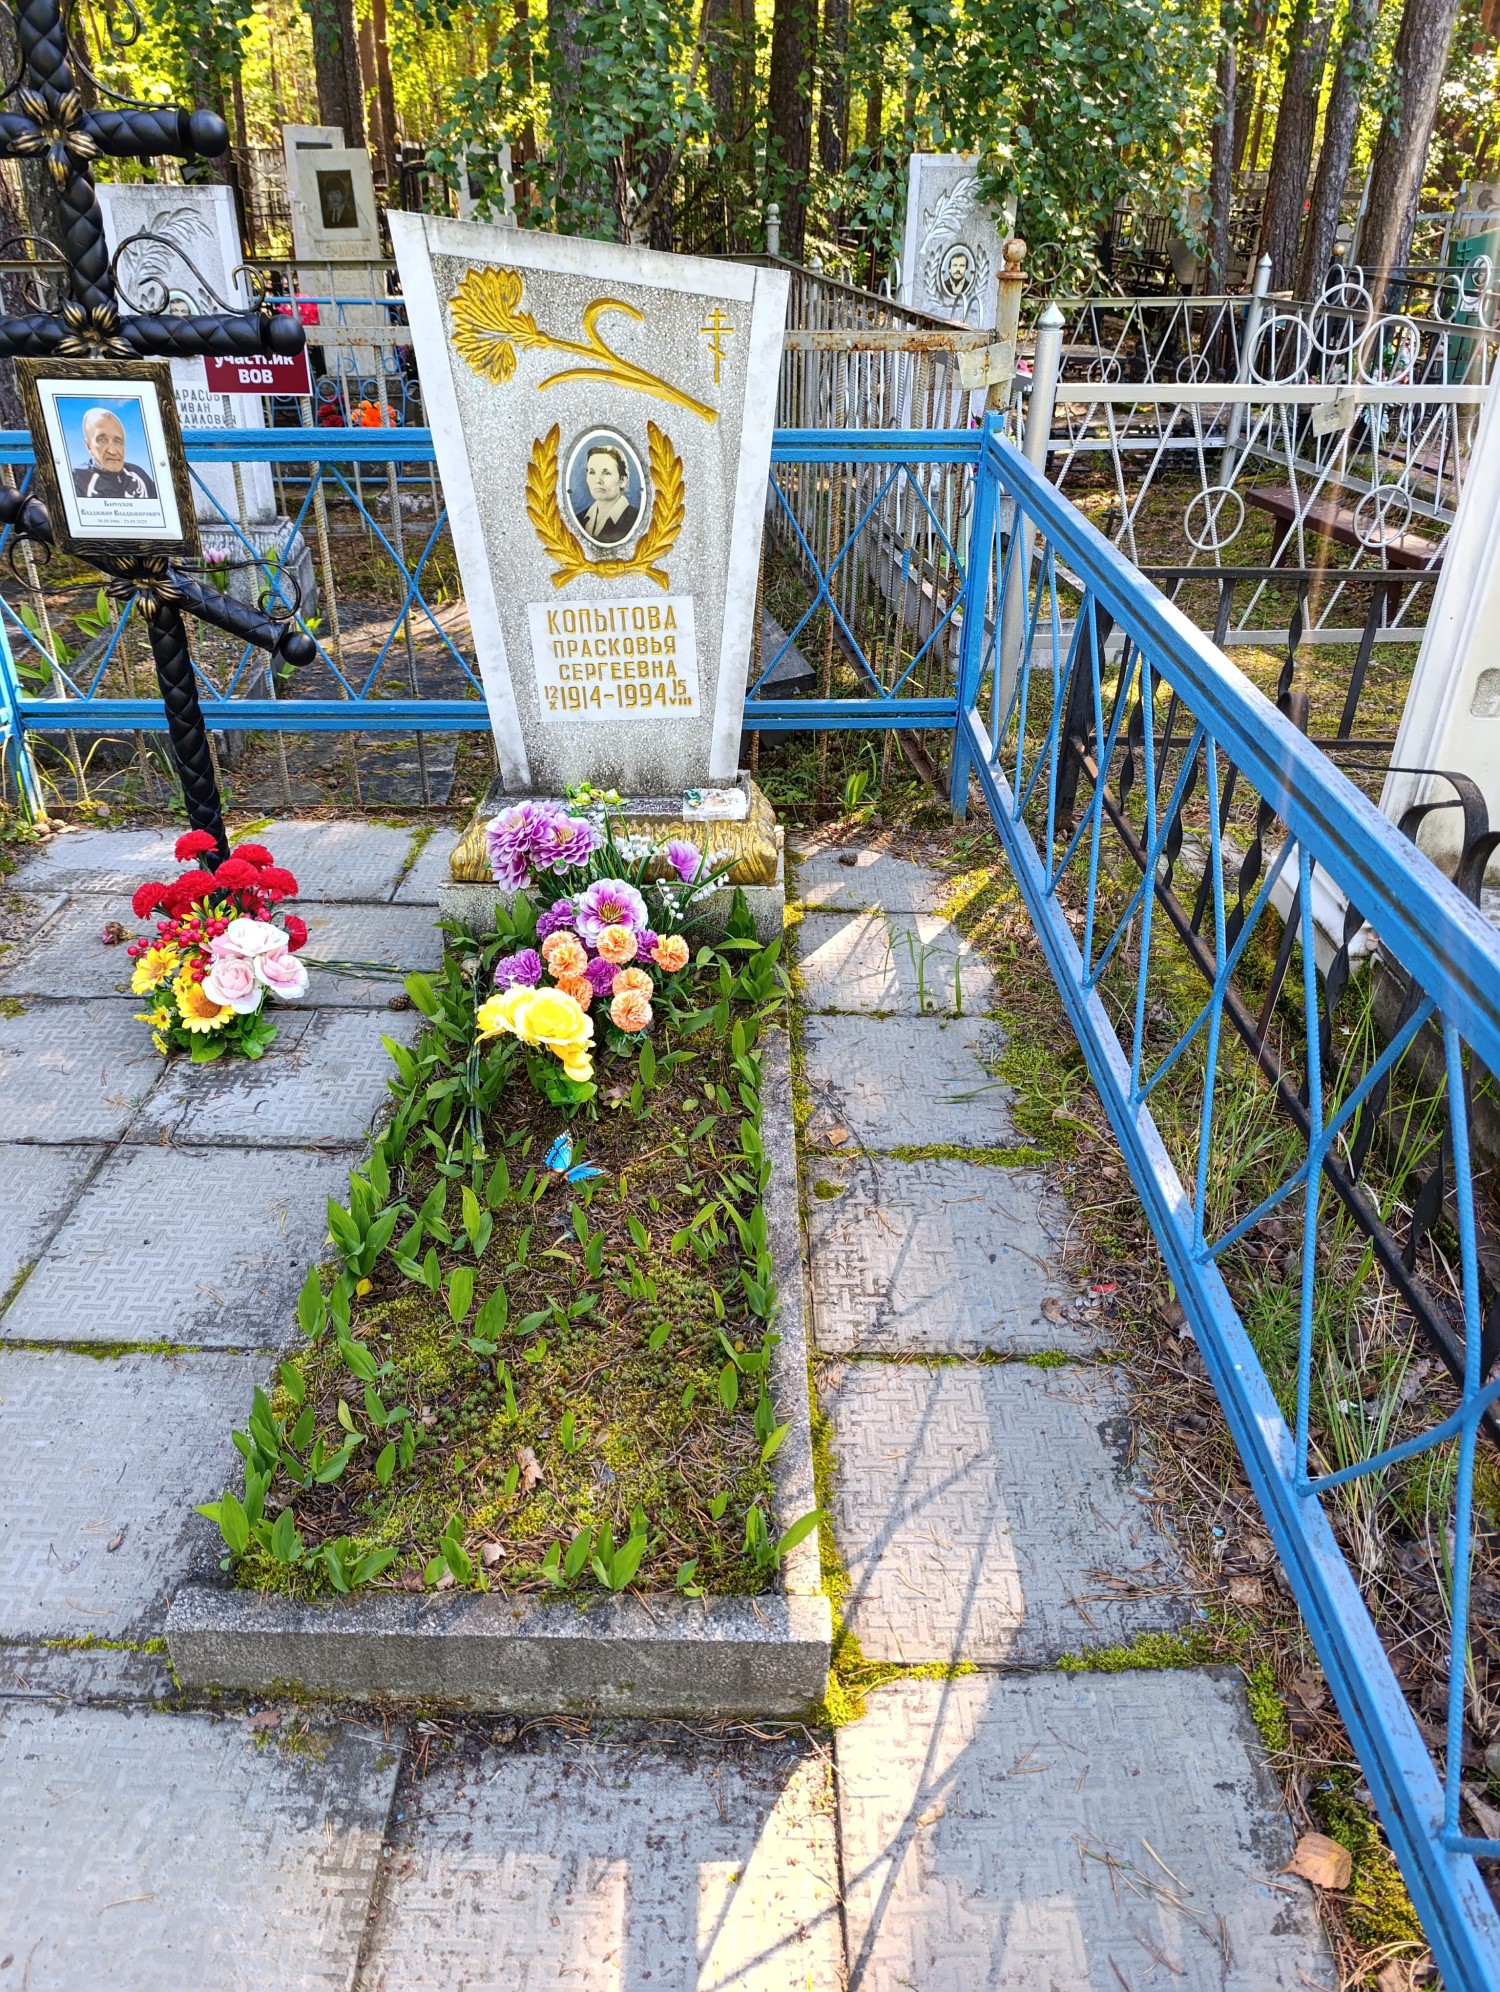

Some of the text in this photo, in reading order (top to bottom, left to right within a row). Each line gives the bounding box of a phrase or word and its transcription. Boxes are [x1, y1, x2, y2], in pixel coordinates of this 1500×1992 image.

[214, 354, 294, 368] участик
[238, 369, 274, 384] ВОВ
[174, 389, 220, 402] АРАСОВ
[180, 402, 211, 413] ИВАН
[81, 508, 161, 517] Владимир Владимирович
[547, 605, 677, 635] КОПЫТОВА
[552, 635, 677, 659] ПРАСКОВЬЯ
[559, 660, 677, 682] СЕРГЕЕВНА
[544, 686, 558, 700] 12
[672, 679, 687, 697] 15
